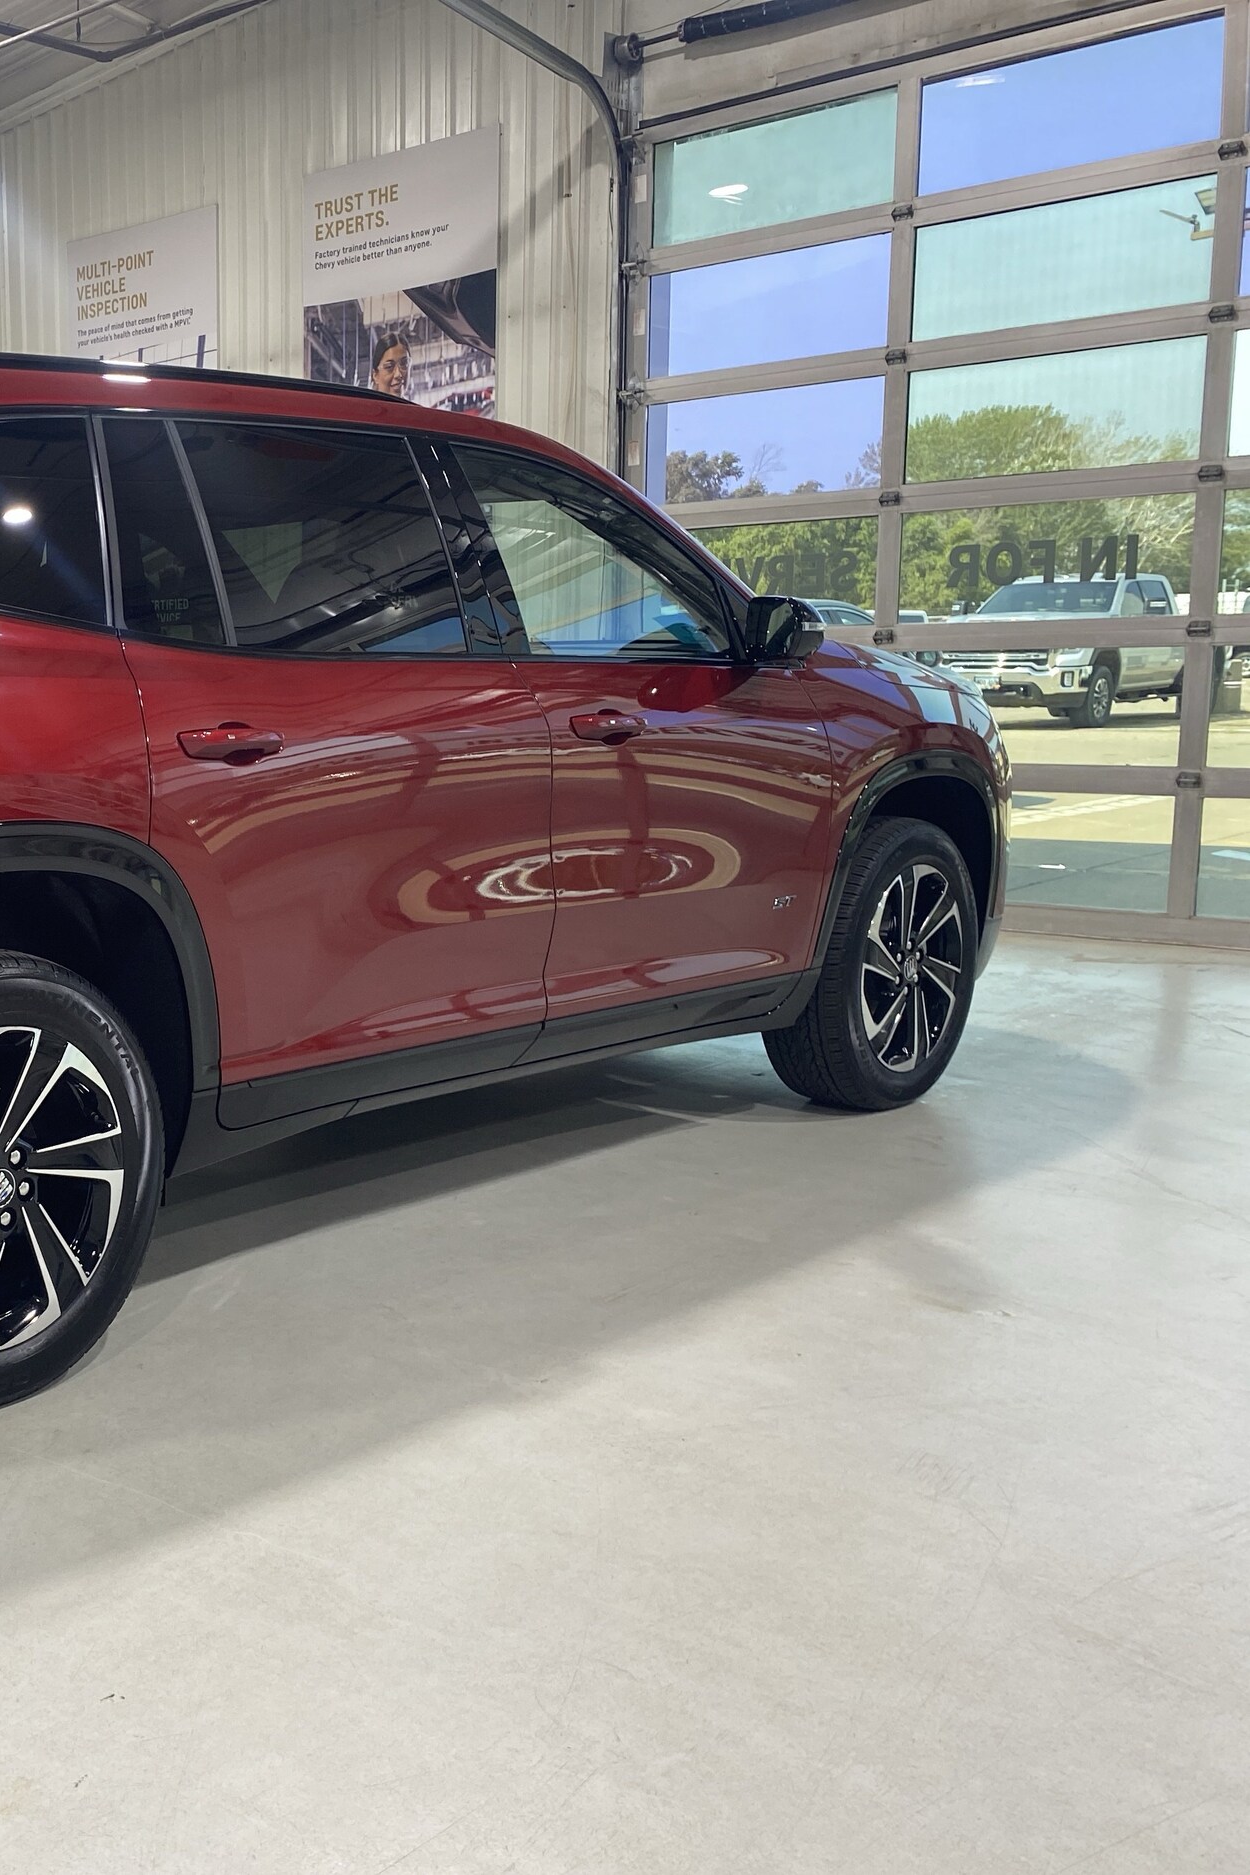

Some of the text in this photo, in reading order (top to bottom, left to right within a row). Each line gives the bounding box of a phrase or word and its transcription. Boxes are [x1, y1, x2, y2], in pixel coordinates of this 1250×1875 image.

[314, 183, 399, 220] TRUST THE
[315, 210, 390, 241] EXPERTS.
[315, 223, 450, 260] Factory trained technicians know your
[315, 241, 432, 270] Chevy vehicle better than anyone.
[77, 250, 154, 282] MULTI-POINT
[77, 277, 126, 301] VEHICLE
[77, 292, 147, 321] INSPECTION
[77, 338, 89, 349] your
[90, 333, 112, 344] vehicle's
[114, 330, 131, 340] health
[132, 326, 154, 337] checked
[156, 322, 168, 331] with
[78, 329, 87, 337] The
[88, 327, 103, 337] peace
[111, 321, 125, 331] mind
[126, 319, 137, 328] that
[138, 316, 156, 326] comes
[157, 312, 171, 322] from
[172, 308, 193, 319] getting
